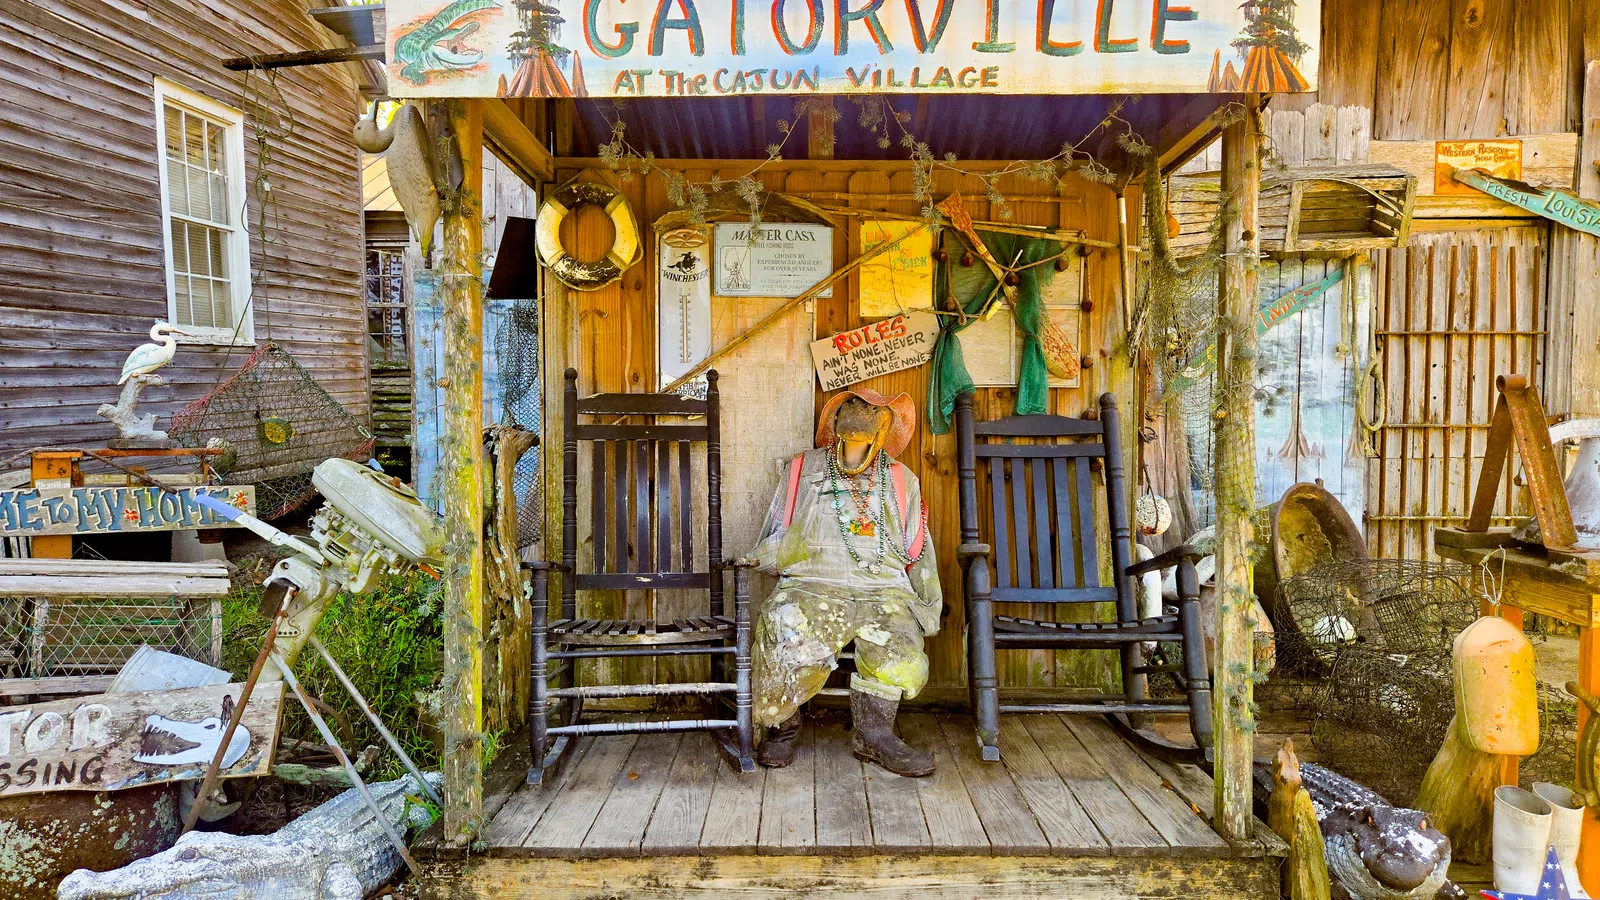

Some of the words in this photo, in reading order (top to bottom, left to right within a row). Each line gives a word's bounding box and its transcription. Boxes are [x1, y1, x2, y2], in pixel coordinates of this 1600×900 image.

[613, 68, 653, 96] AT
[713, 65, 821, 95] CAJUN
[1442, 145, 1476, 157] WESTERN
[1478, 143, 1509, 155] RESERVE
[1486, 181, 1529, 206] FRESH
[785, 229, 817, 241] CAST
[662, 269, 709, 282] WINCHESTER
[832, 316, 907, 355] RULES
[884, 332, 926, 352] NEVER
[826, 372, 862, 390] NEVER
[889, 361, 900, 371] BE
[833, 362, 859, 377] WAS
[71, 487, 128, 532] MY
